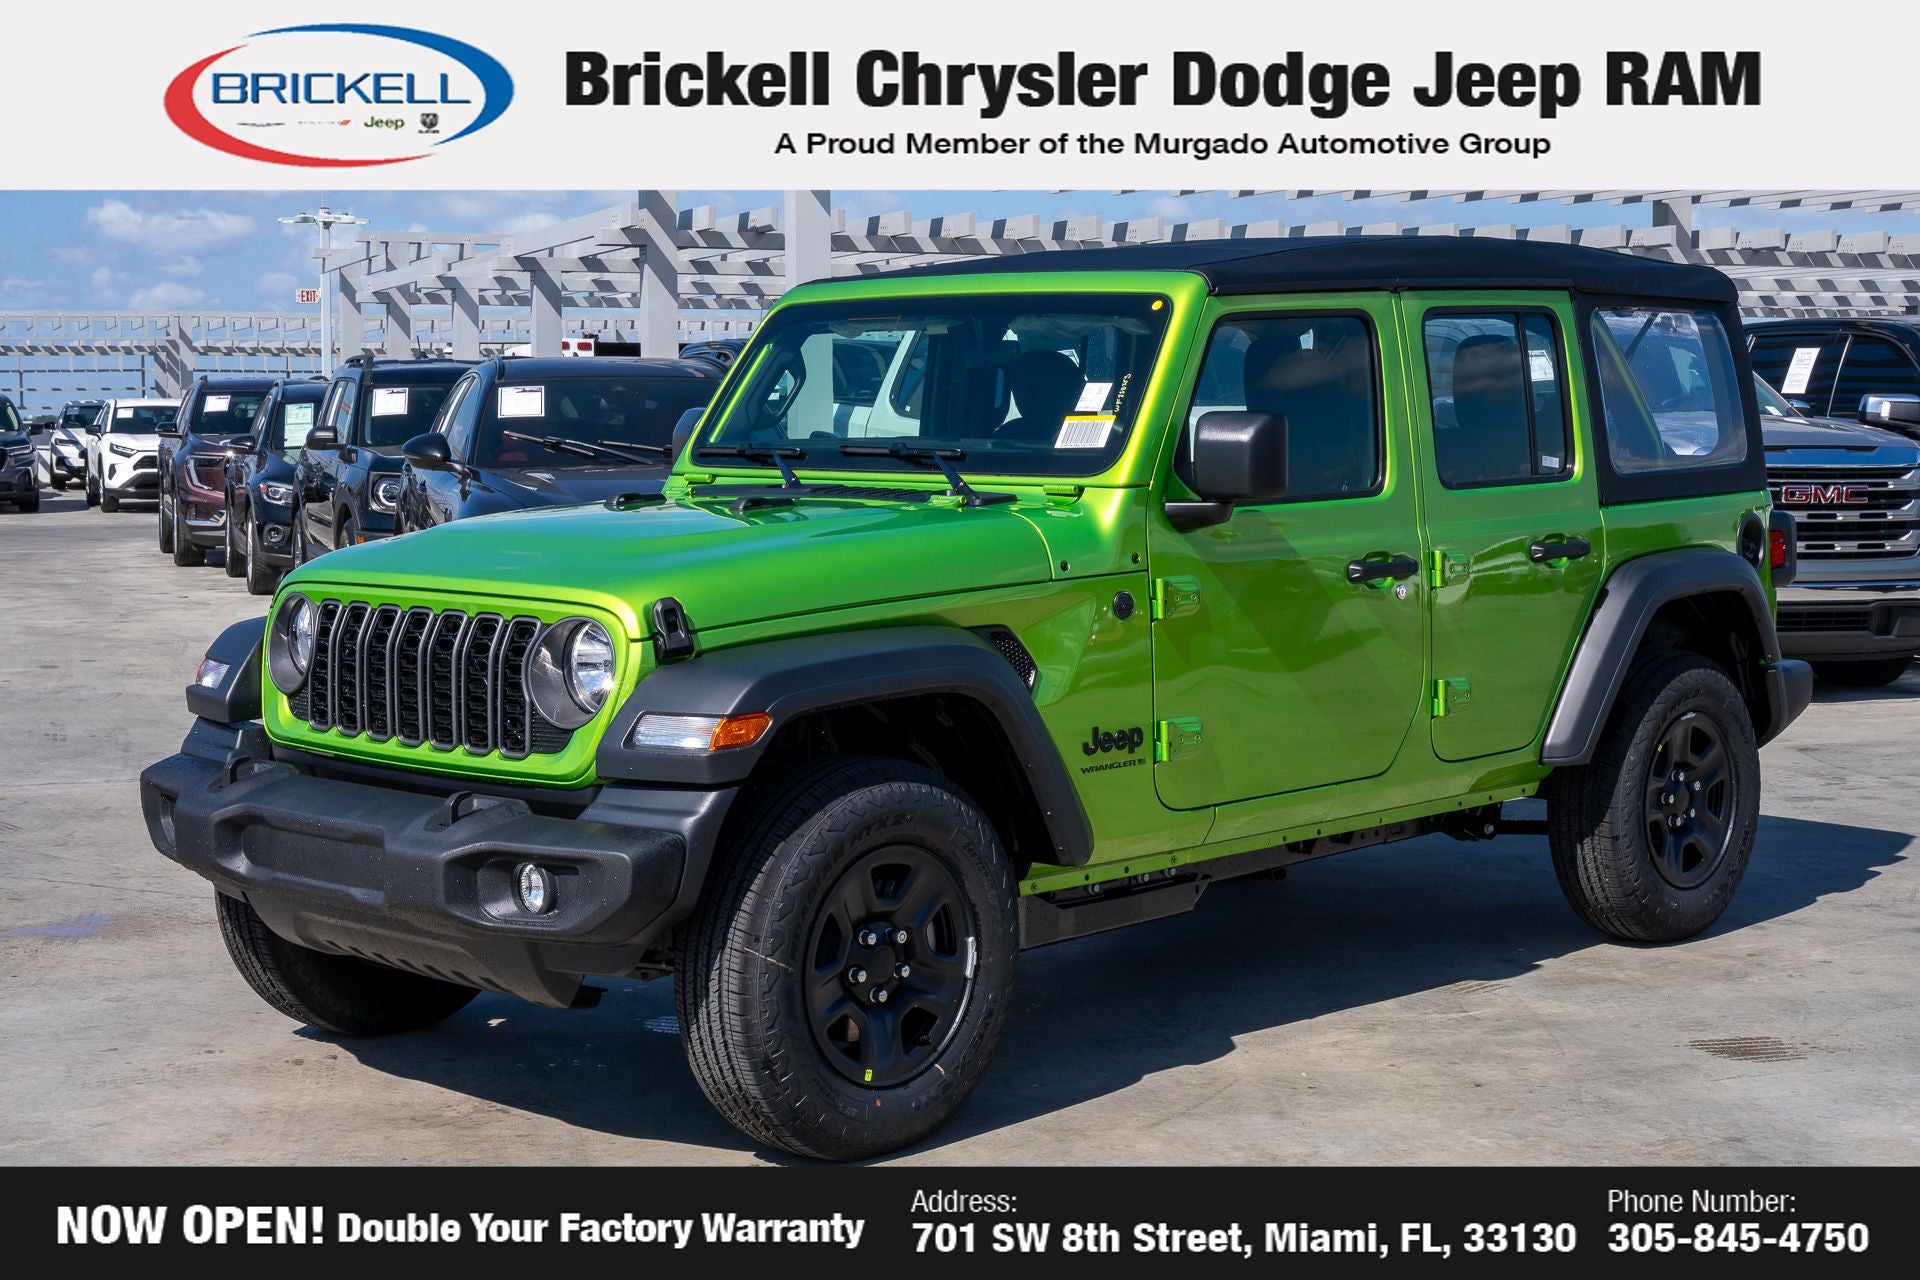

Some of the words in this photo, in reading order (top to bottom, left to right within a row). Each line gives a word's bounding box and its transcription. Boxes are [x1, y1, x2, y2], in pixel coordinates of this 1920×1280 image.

[301, 290, 316, 302] EXIT
[1782, 485, 1869, 503] GMC
[1082, 726, 1144, 756] Jeep
[1080, 759, 1137, 774] WRANGLER
